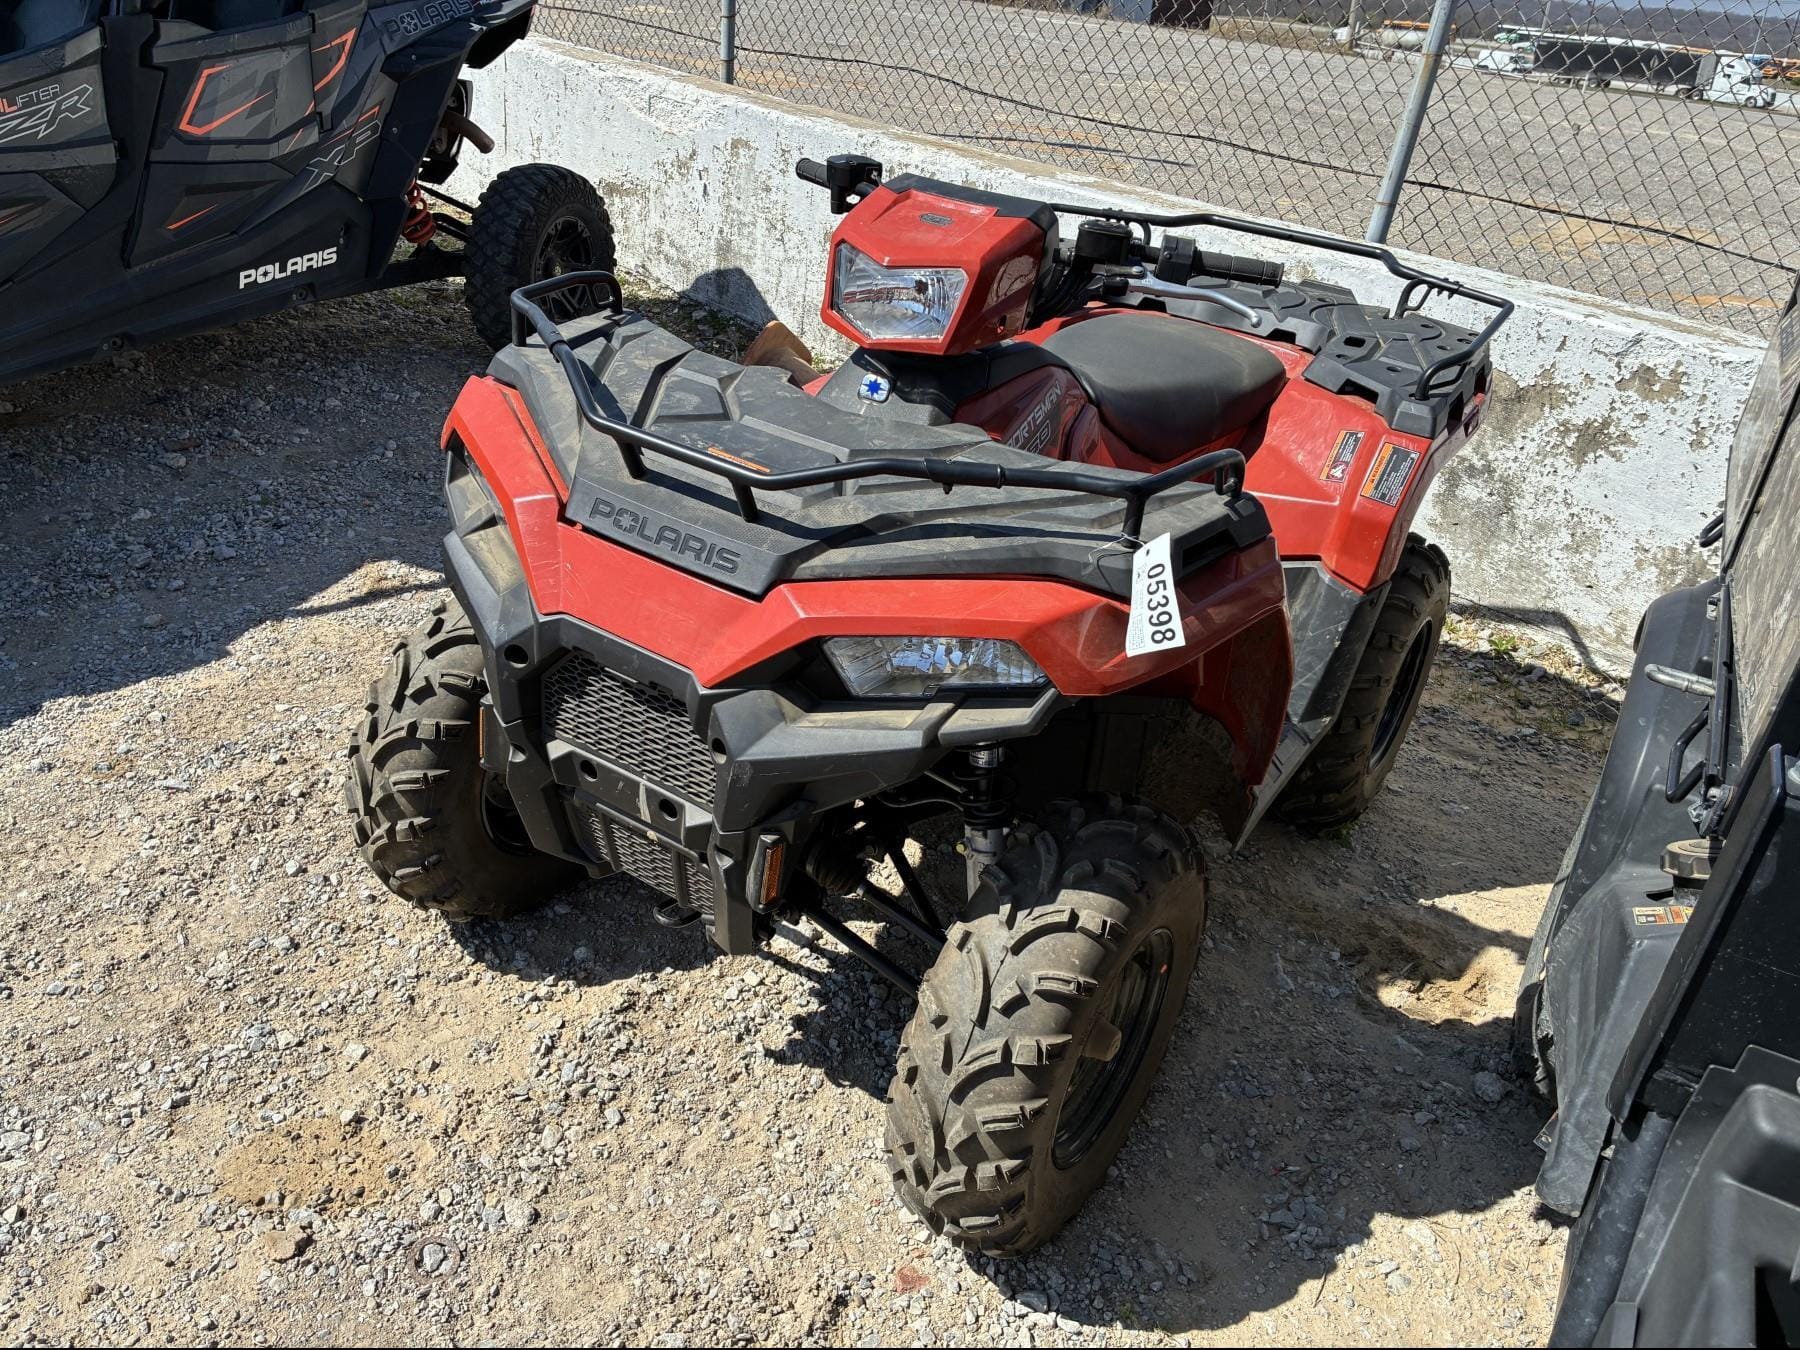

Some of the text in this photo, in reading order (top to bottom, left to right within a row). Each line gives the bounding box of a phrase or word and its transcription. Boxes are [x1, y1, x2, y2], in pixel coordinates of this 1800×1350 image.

[299, 120, 381, 197] XP
[239, 247, 337, 290] POLARIS
[589, 497, 741, 574] POLARIS
[1147, 563, 1176, 644] 05398
